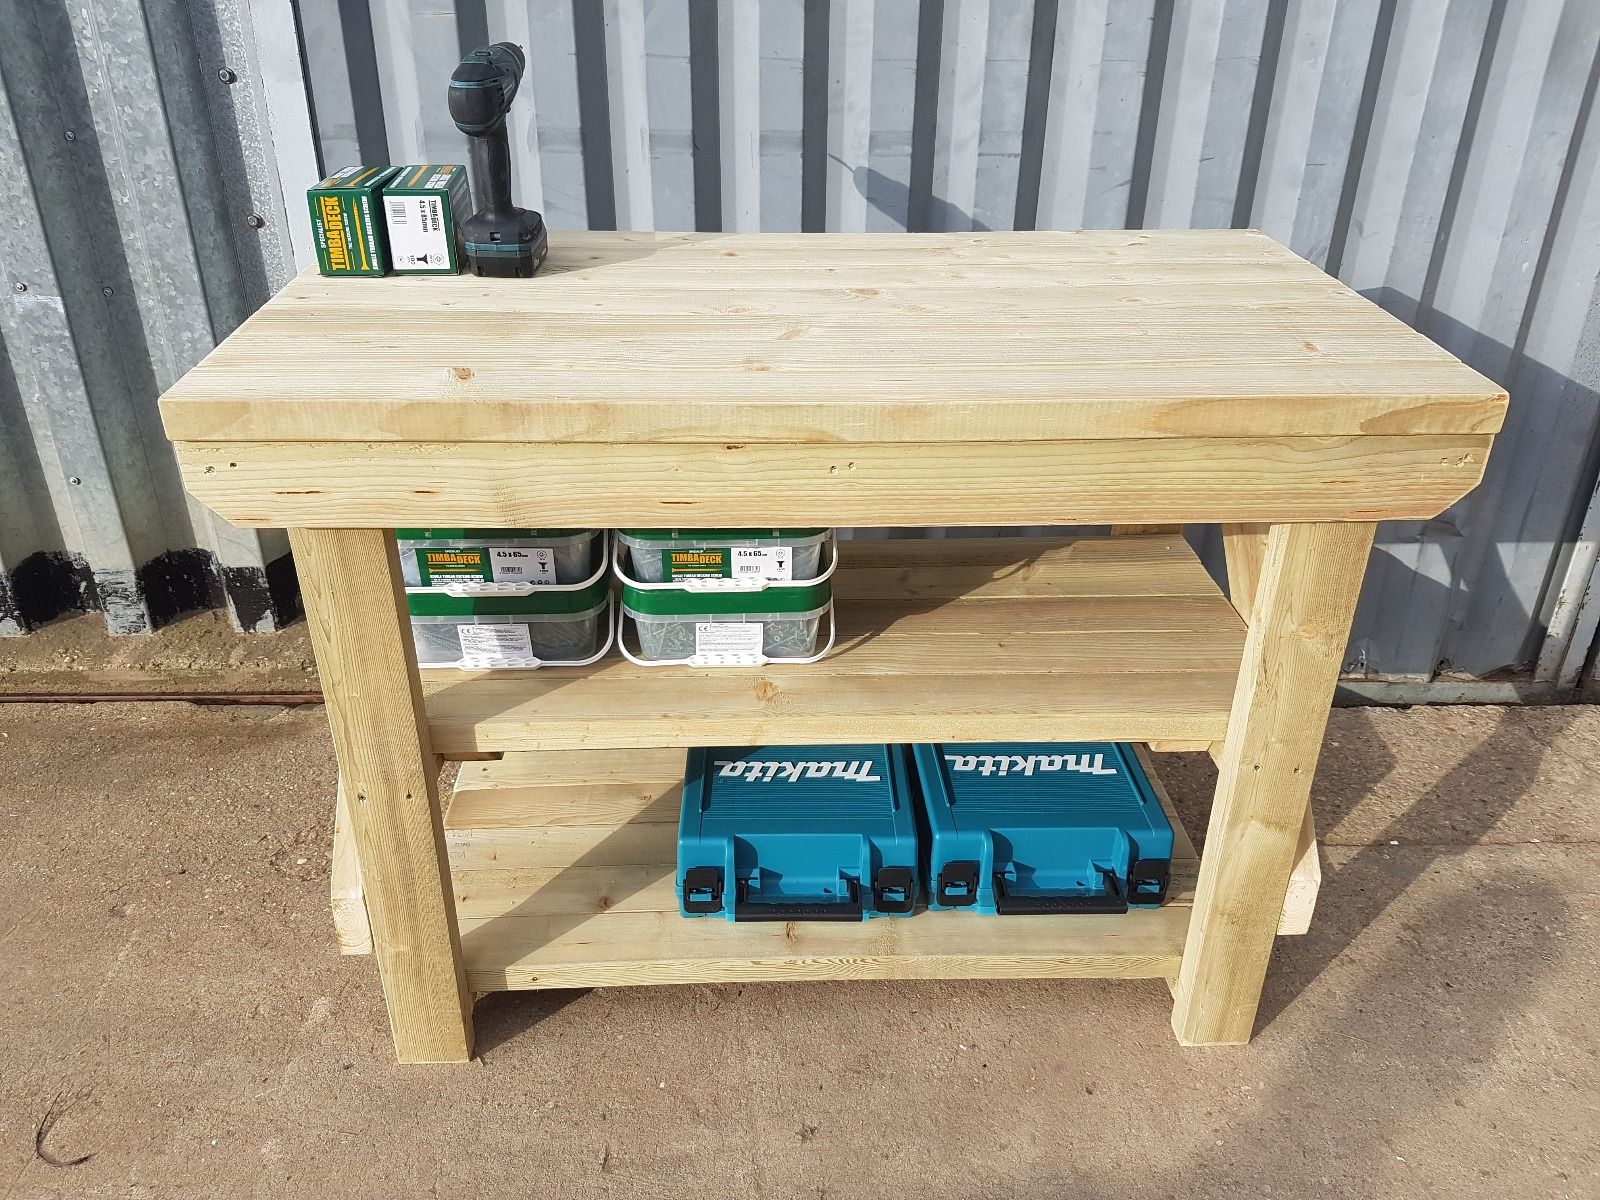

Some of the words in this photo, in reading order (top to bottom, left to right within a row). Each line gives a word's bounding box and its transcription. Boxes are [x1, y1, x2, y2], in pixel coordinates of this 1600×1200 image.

[429, 199, 441, 232] TIMBADECK
[316, 218, 327, 249] SPECIALIST
[324, 196, 347, 271] TIMBADECK
[426, 553, 481, 564] TIMBADECK
[671, 553, 722, 564] TIMBADECK
